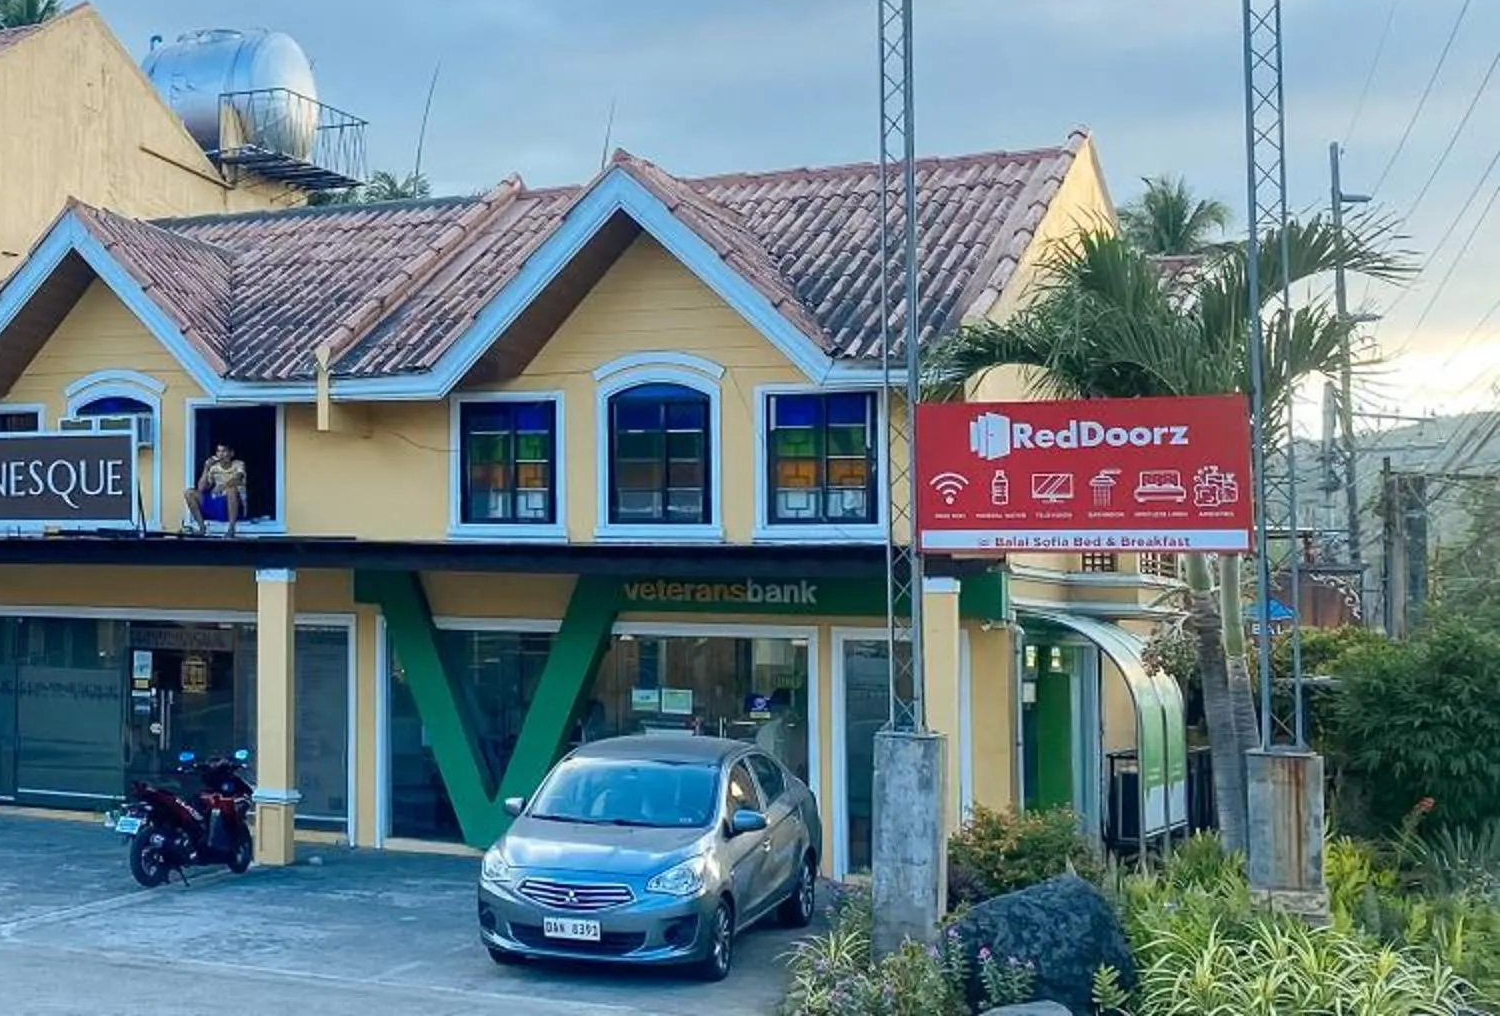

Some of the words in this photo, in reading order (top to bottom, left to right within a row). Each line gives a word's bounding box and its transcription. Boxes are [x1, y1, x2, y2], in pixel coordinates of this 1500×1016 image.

[1013, 419, 1189, 449] RedDoorz
[1033, 536, 1069, 547] Sofia
[1074, 536, 1101, 547] Bed
[1105, 537, 1116, 546] &
[1121, 535, 1191, 547] Breakfast
